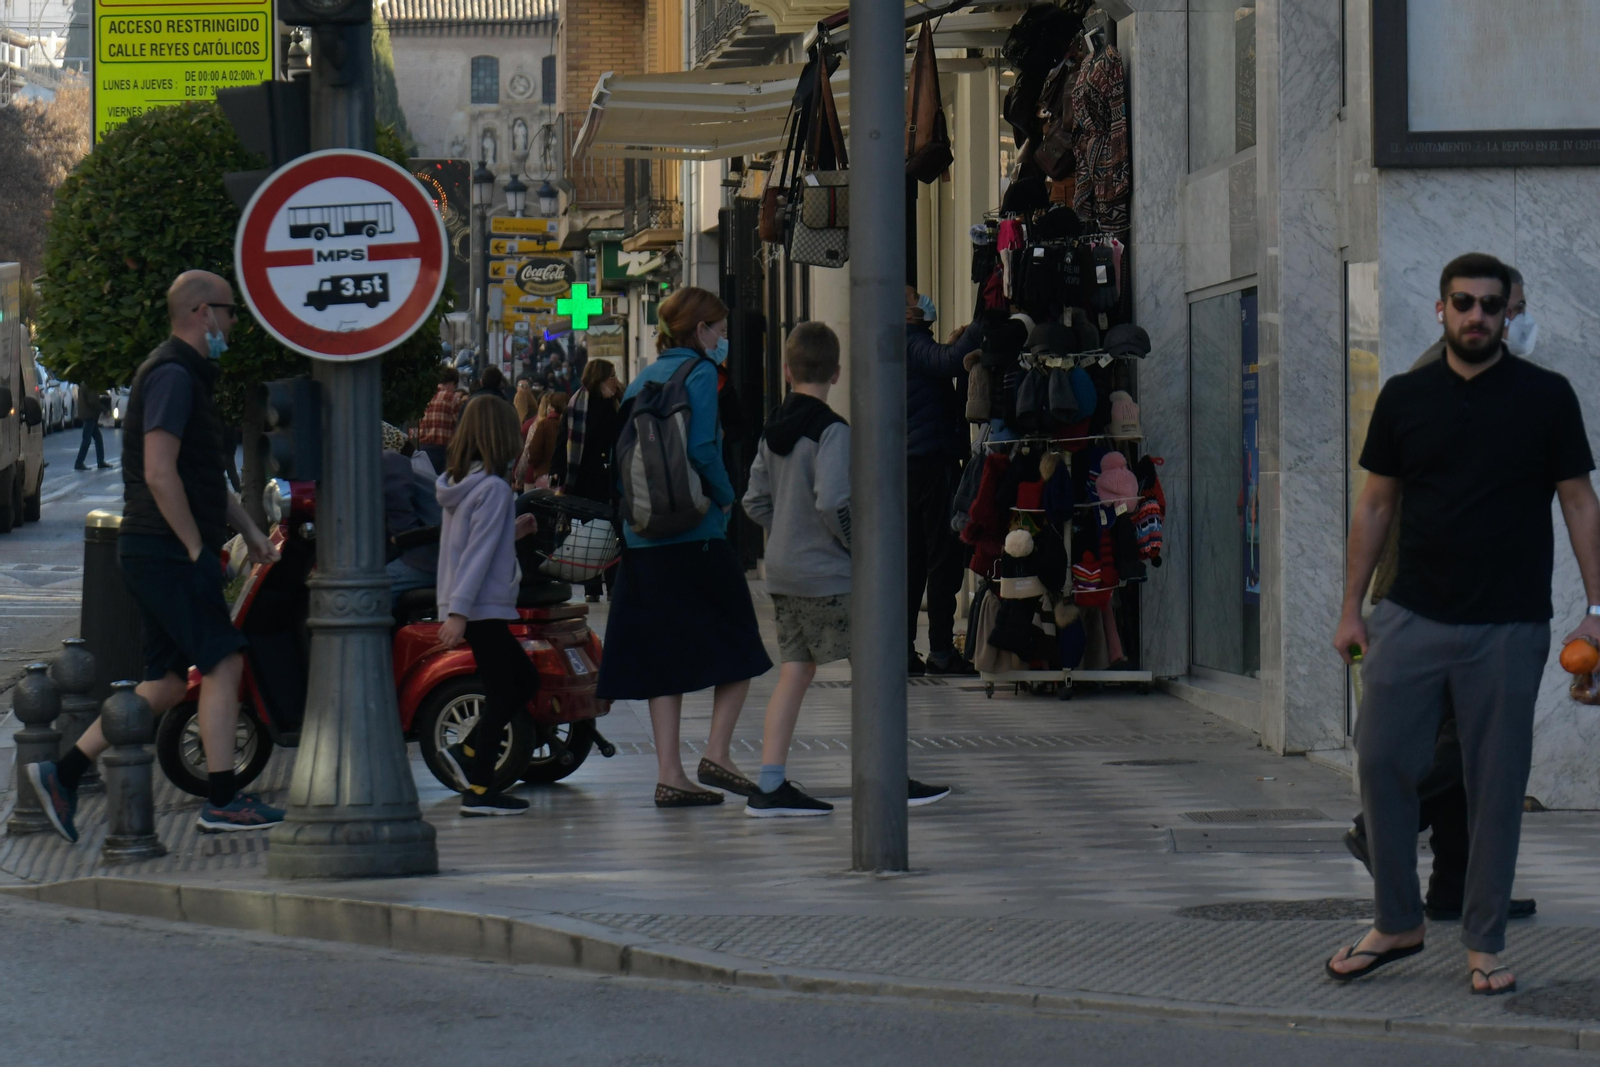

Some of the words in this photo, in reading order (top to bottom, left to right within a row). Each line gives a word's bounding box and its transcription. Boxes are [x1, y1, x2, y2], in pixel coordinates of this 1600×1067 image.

[108, 20, 162, 34] ACCESO
[166, 18, 259, 33] RESTRINGIDO
[108, 43, 146, 57] CALLE
[150, 42, 190, 56] REYES
[193, 38, 260, 56] CATÓLICOS
[185, 71, 196, 82] DE
[198, 70, 219, 81] 00:00
[221, 70, 227, 81] A
[229, 70, 257, 81] 02:00h.
[258, 69, 264, 80] Y
[102, 79, 131, 91] LUNES
[132, 79, 139, 90] A
[185, 85, 196, 96] DE
[107, 106, 143, 117] VIERNES
[1404, 141, 1472, 153] AYUNTAMIENTO
[1487, 141, 1500, 152] LA
[1535, 140, 1548, 152] EN
[1549, 140, 1561, 151] EL
[1563, 140, 1573, 150] IV
[316, 248, 366, 262] MPS
[340, 275, 384, 297] 3,5t
